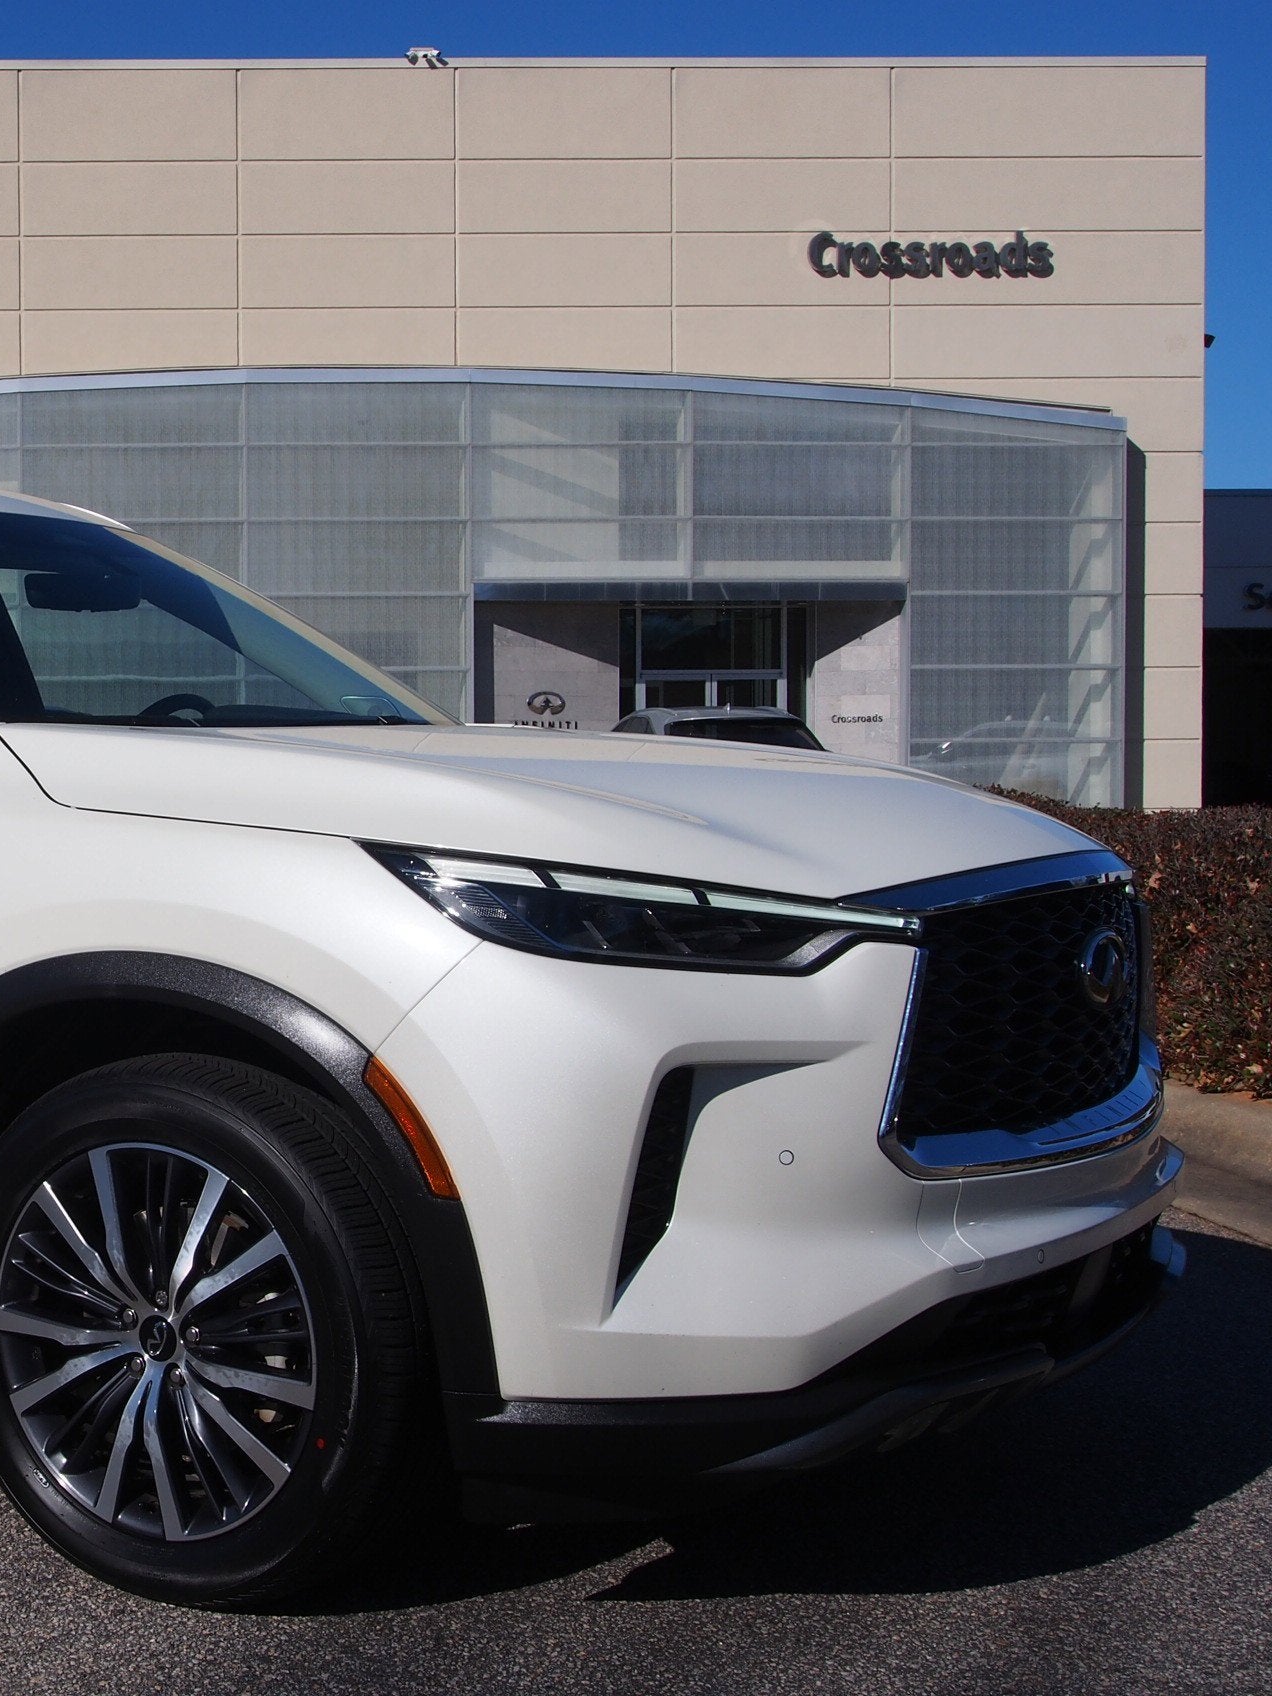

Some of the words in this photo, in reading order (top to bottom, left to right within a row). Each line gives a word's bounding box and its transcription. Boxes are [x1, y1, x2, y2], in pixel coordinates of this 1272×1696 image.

[808, 230, 1054, 278] Crossroads
[1243, 582, 1272, 610] S
[831, 713, 883, 724] Crossroads
